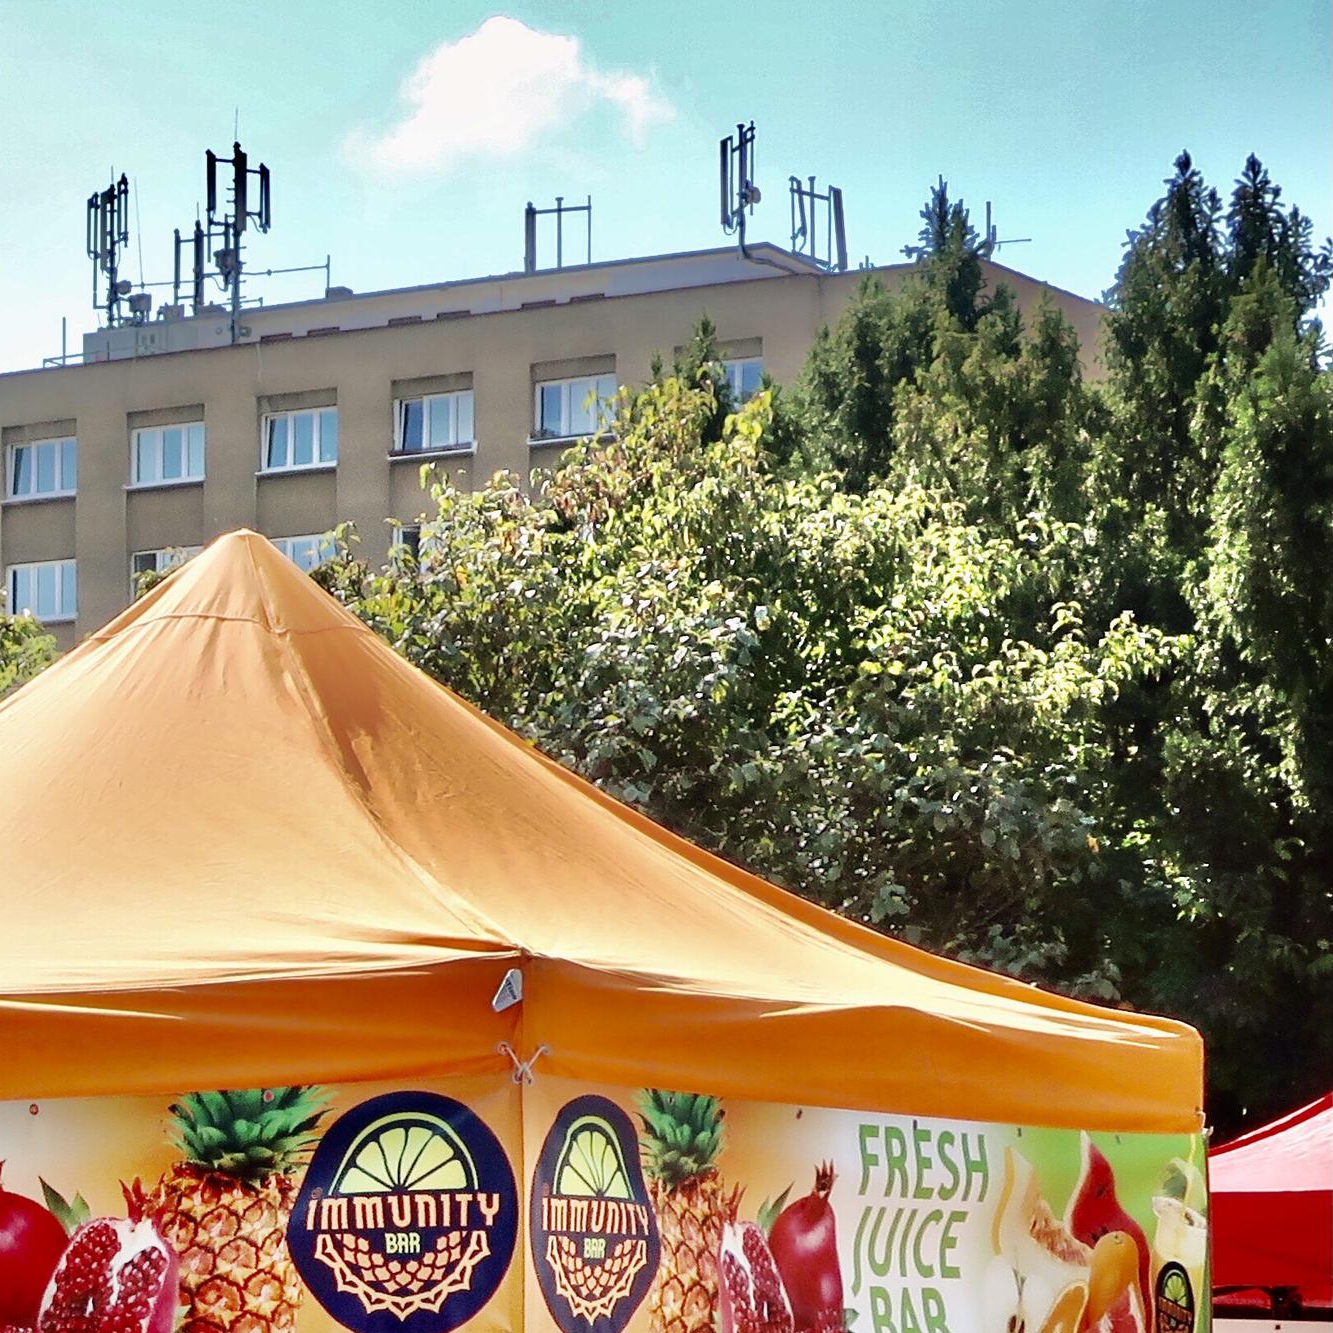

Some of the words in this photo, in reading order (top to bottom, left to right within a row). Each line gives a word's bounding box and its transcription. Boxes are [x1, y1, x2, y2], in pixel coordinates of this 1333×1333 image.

[858, 1124, 989, 1202] FRESH
[306, 1193, 500, 1231] IMMUNITY
[542, 1197, 649, 1236] IMMUNITY
[384, 1232, 421, 1254] BAR
[851, 1206, 968, 1297] JUICE
